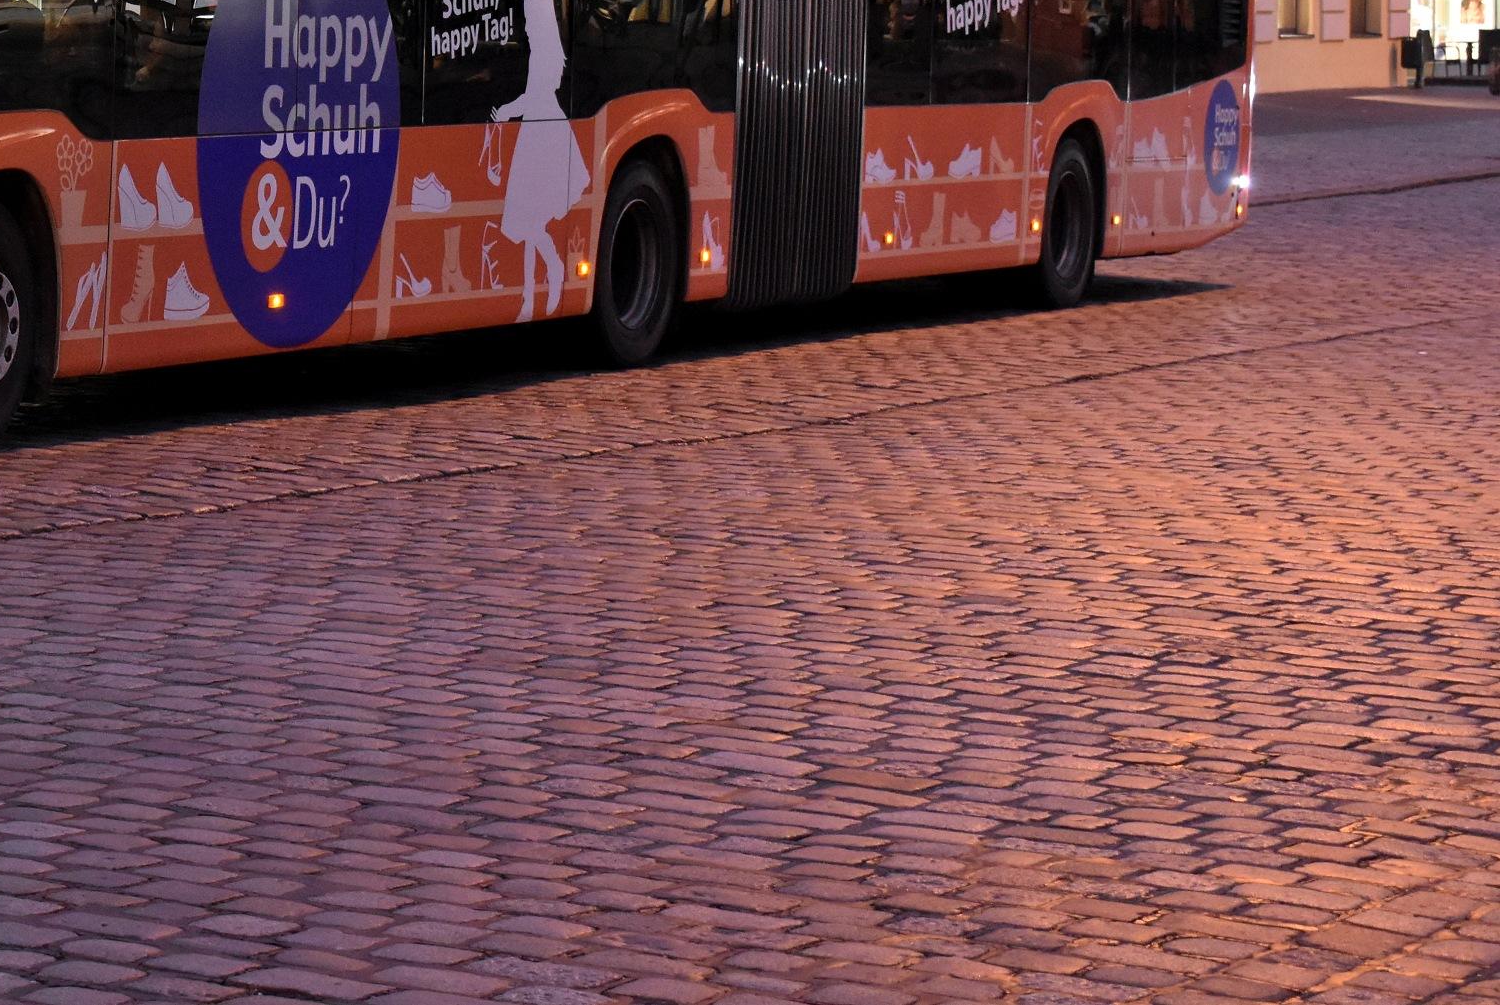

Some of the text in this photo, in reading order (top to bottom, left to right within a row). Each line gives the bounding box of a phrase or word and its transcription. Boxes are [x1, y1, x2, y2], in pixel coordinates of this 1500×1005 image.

[431, 8, 514, 59] happy Tag!
[260, 84, 381, 160] Schuh
[1214, 103, 1238, 125] Happy
[251, 173, 351, 251] & Du?
